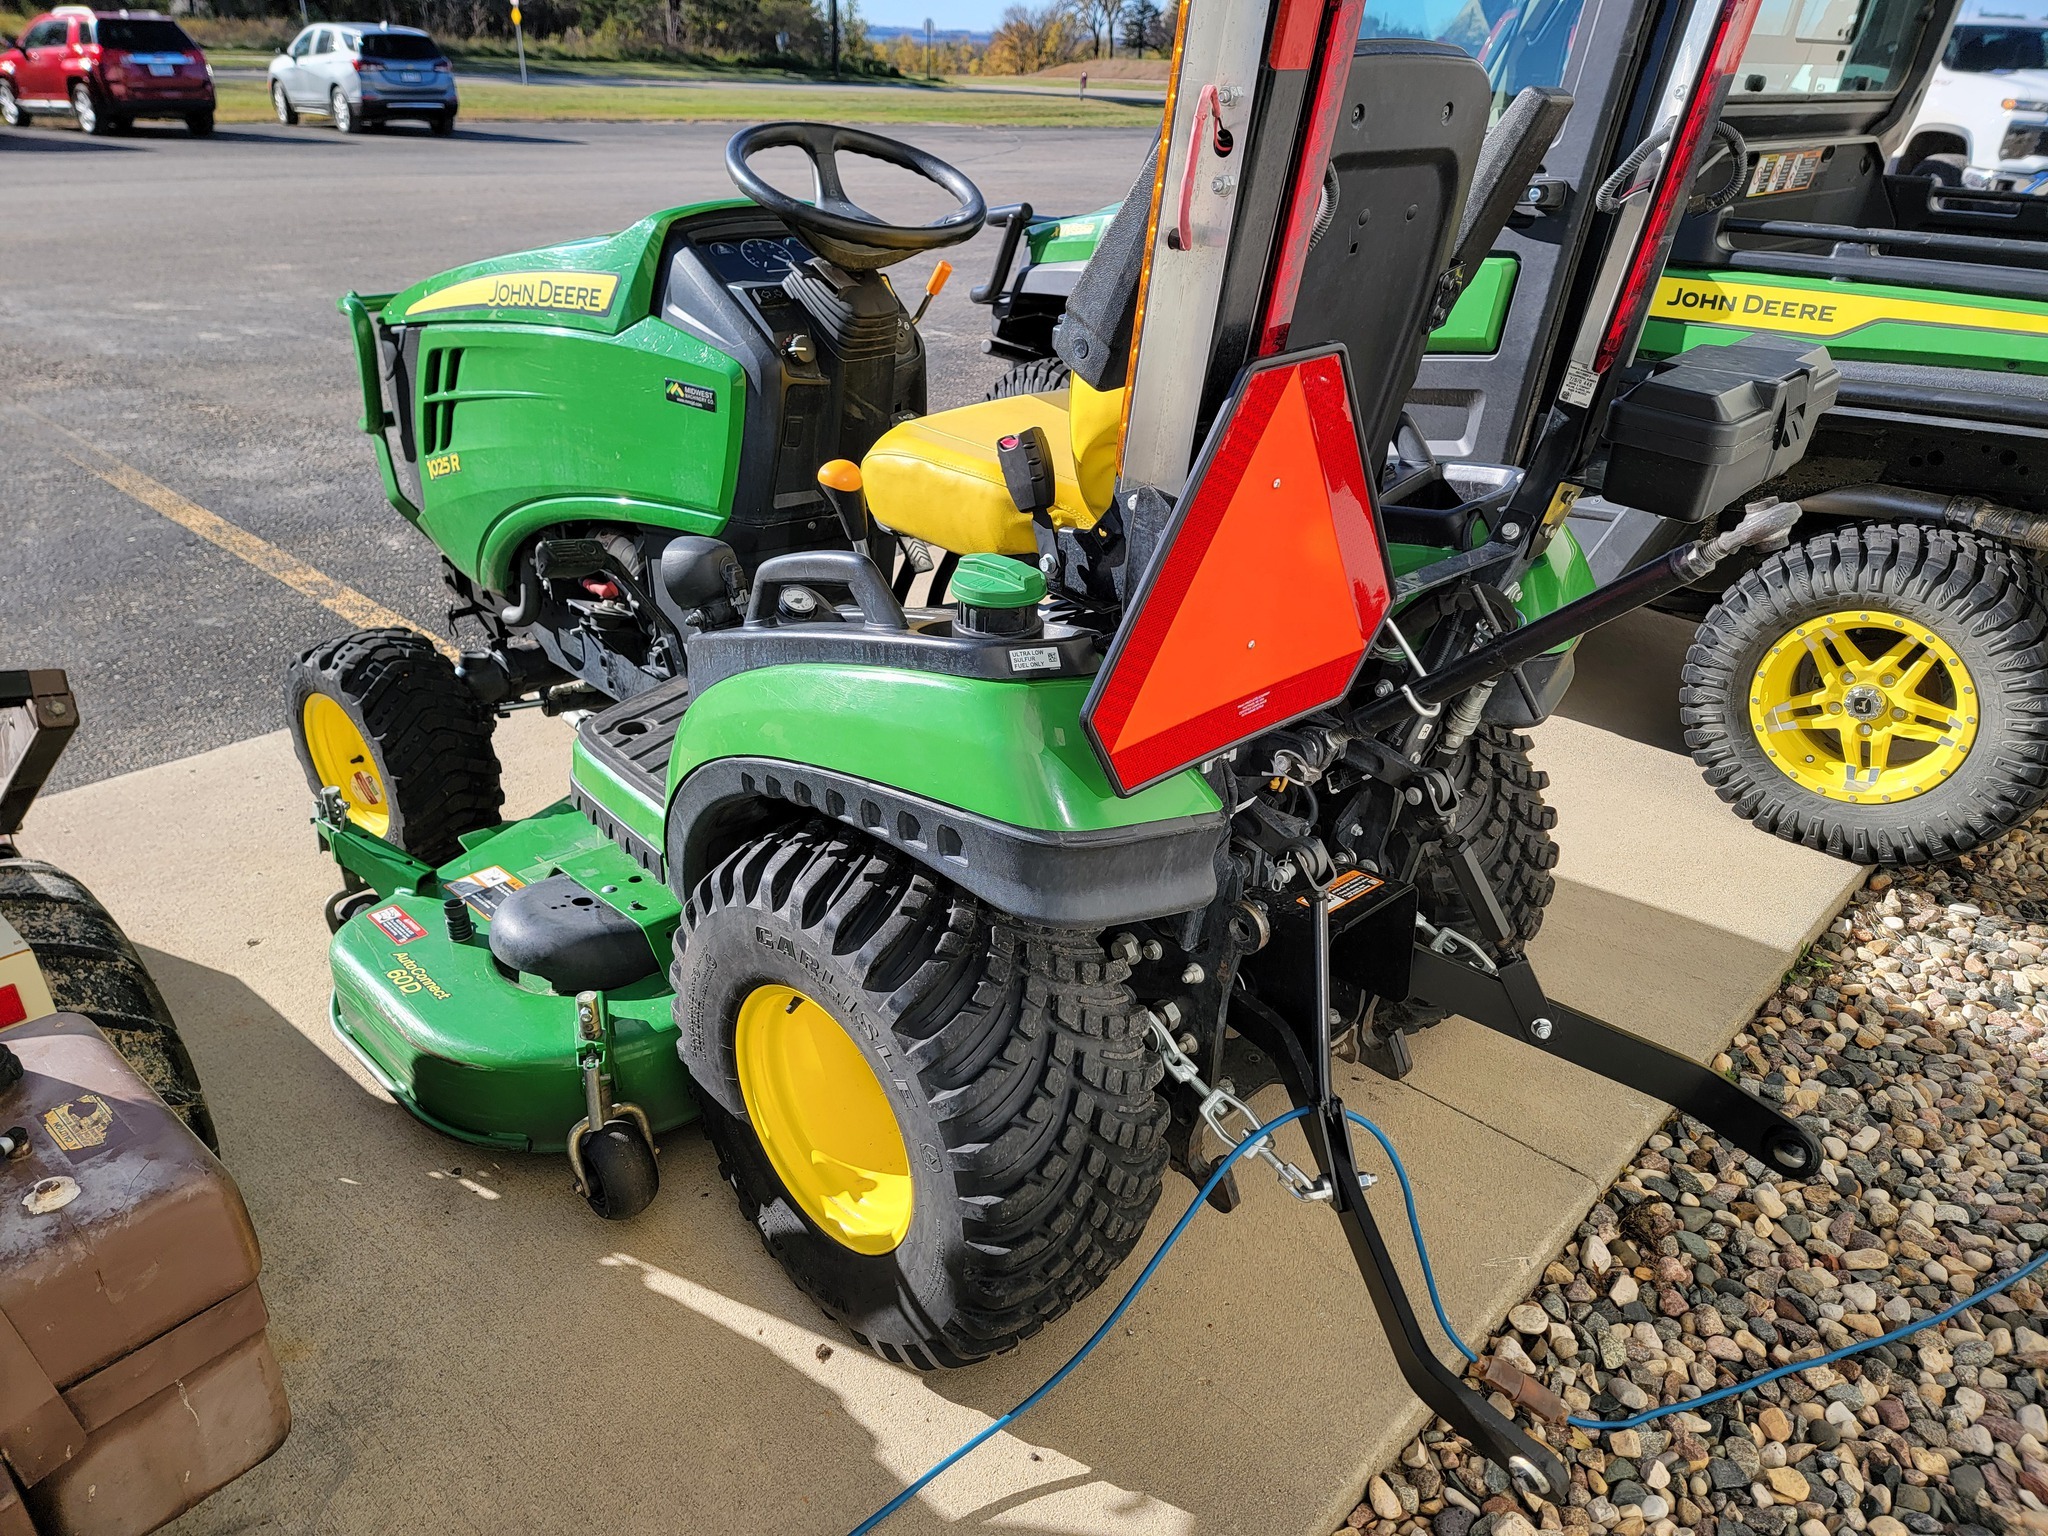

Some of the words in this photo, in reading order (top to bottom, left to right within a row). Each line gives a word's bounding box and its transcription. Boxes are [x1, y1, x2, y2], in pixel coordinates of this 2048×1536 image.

[488, 280, 535, 303] JOHN
[538, 280, 602, 308] DEERE
[1666, 287, 1738, 312] JOHN
[1742, 294, 1837, 323] DEERE
[684, 386, 713, 399] MIDWEST
[1013, 656, 1036, 664] SULFUR
[386, 969, 423, 994] 60D
[392, 952, 452, 1000] AutoConnect
[756, 925, 918, 1109] CARLISLE
